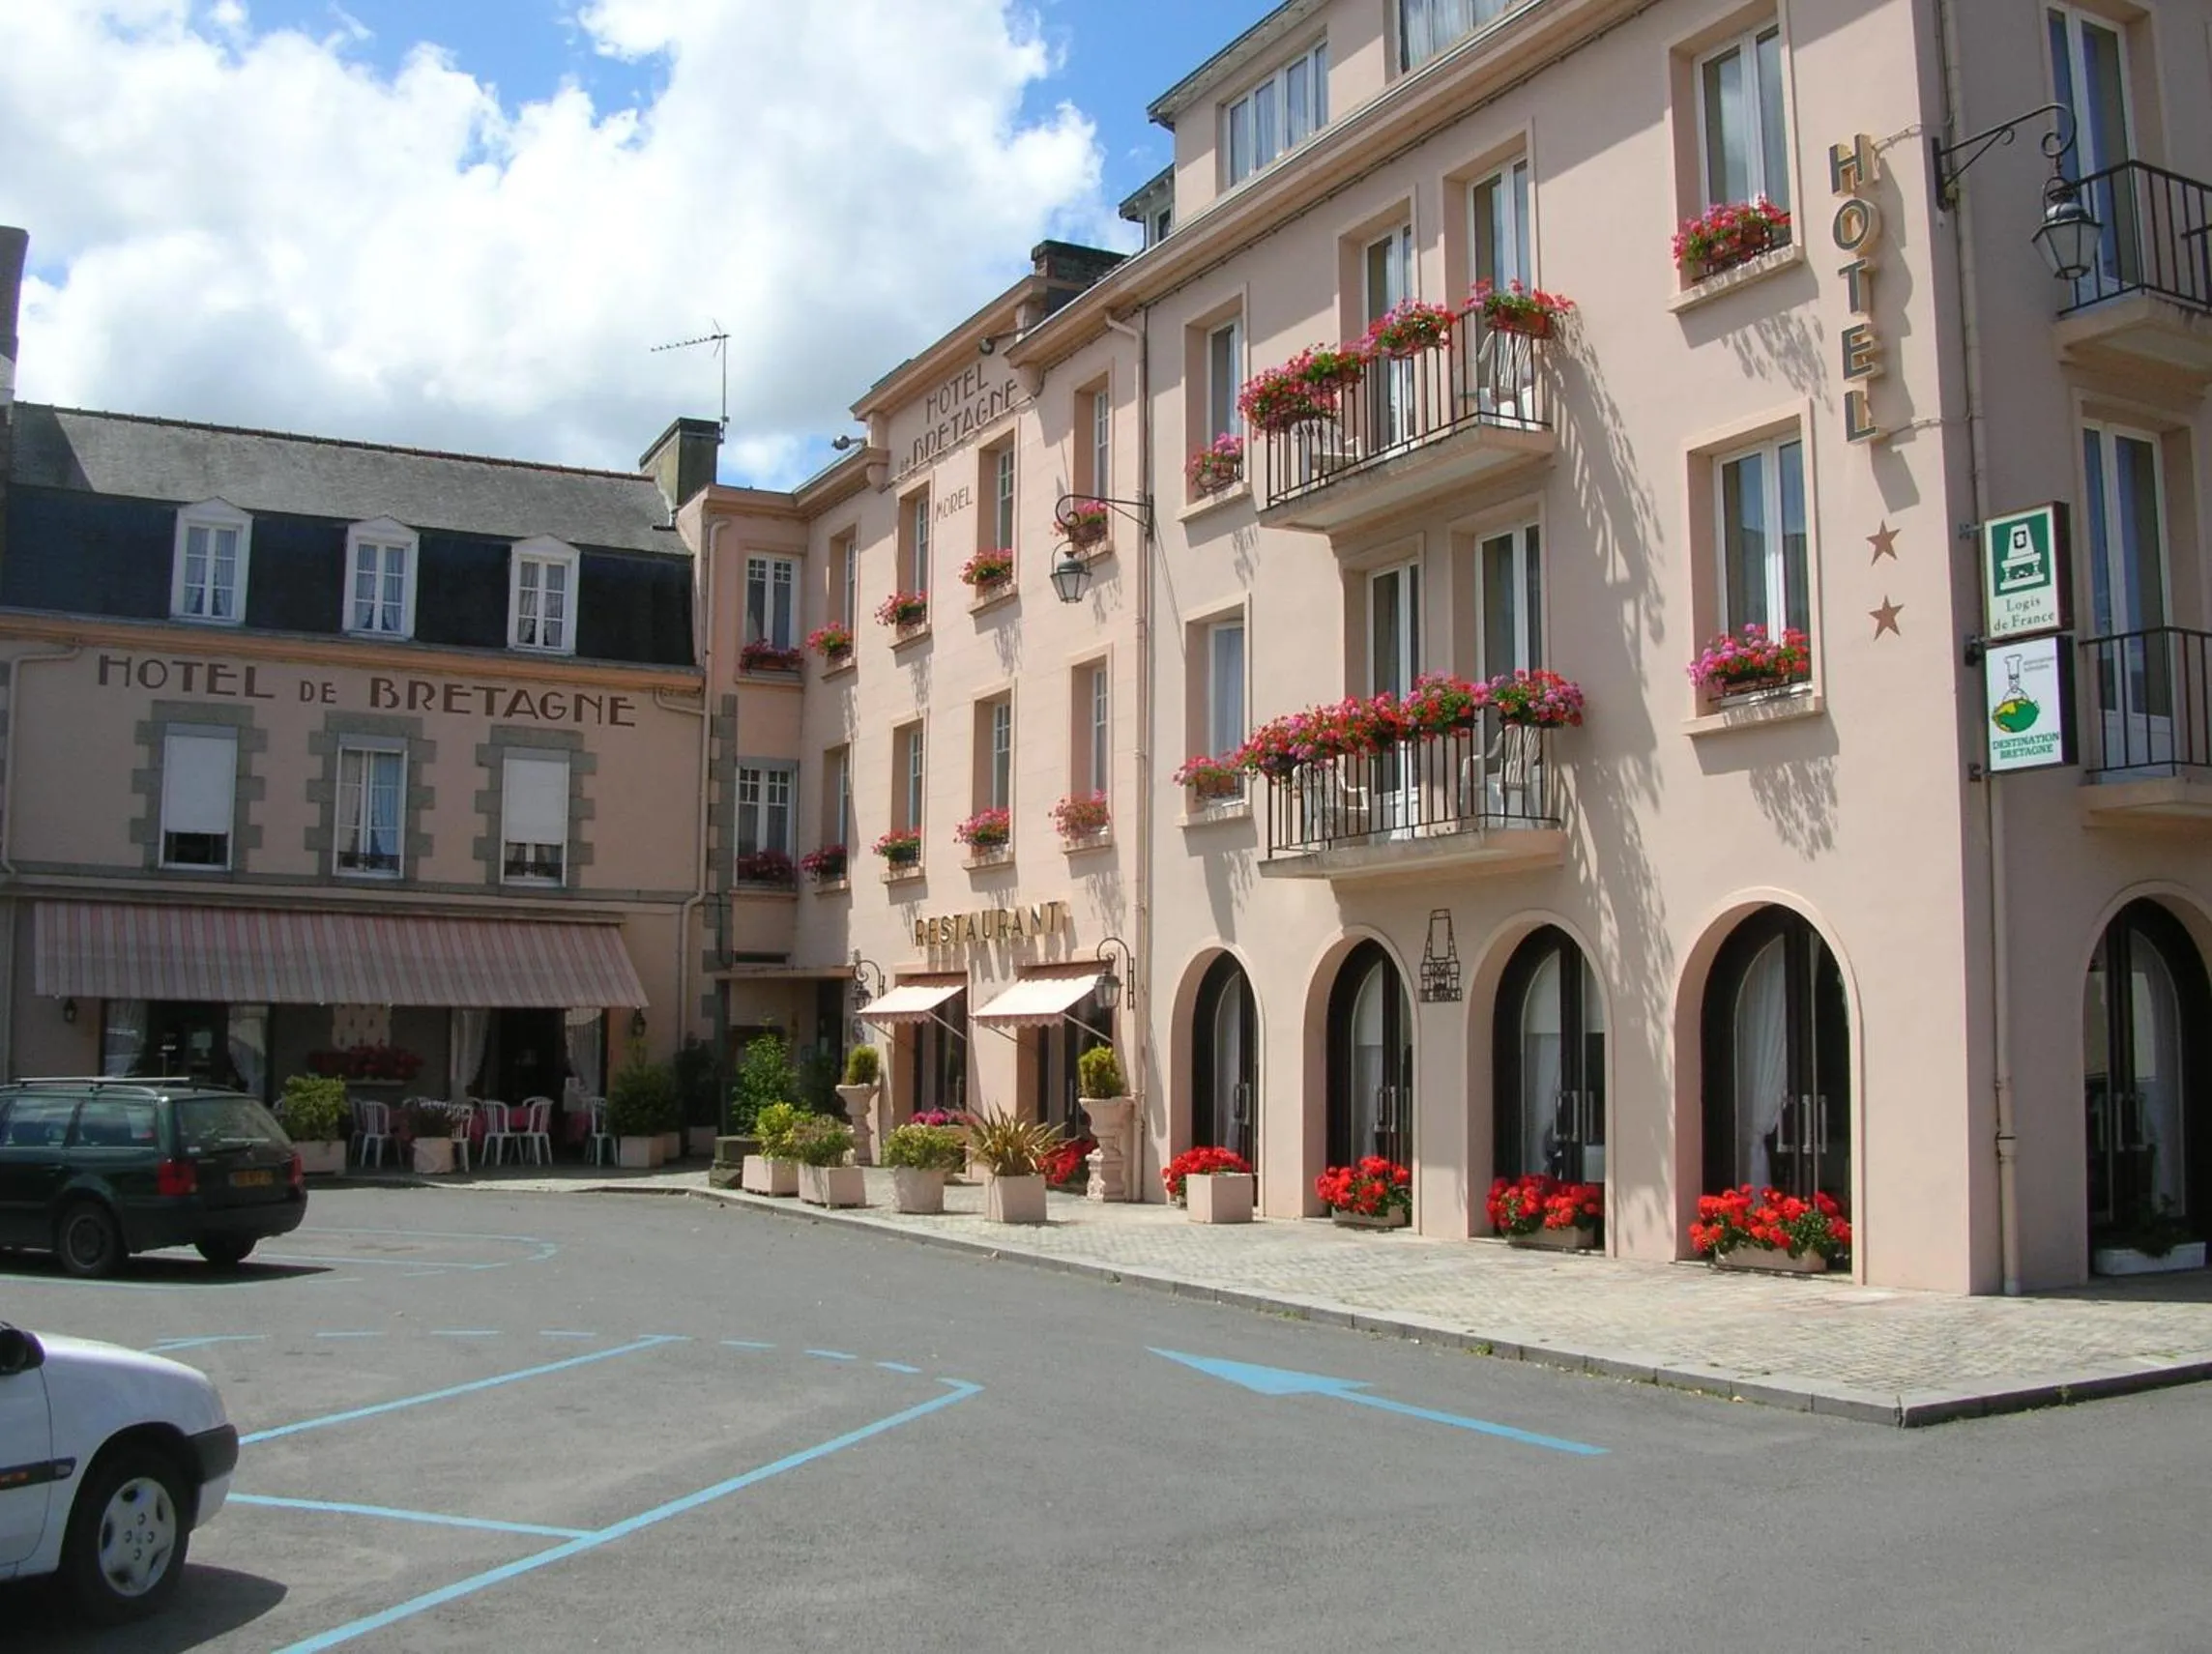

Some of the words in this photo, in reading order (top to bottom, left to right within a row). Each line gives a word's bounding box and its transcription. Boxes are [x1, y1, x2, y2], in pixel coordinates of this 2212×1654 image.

[1828, 132, 1880, 442] HOTEL
[914, 379, 1017, 465] BRETAGNE
[2006, 596, 2041, 612] Logis
[1994, 619, 2009, 631] de
[2011, 612, 2054, 627] France
[99, 654, 276, 699] HOTEL
[300, 681, 336, 704] DE
[370, 678, 636, 727] BRETAGNE
[1993, 732, 2059, 750] DESTINATION
[2000, 743, 2053, 760] BRETAGNE
[916, 901, 1070, 946] RESTAURANT
